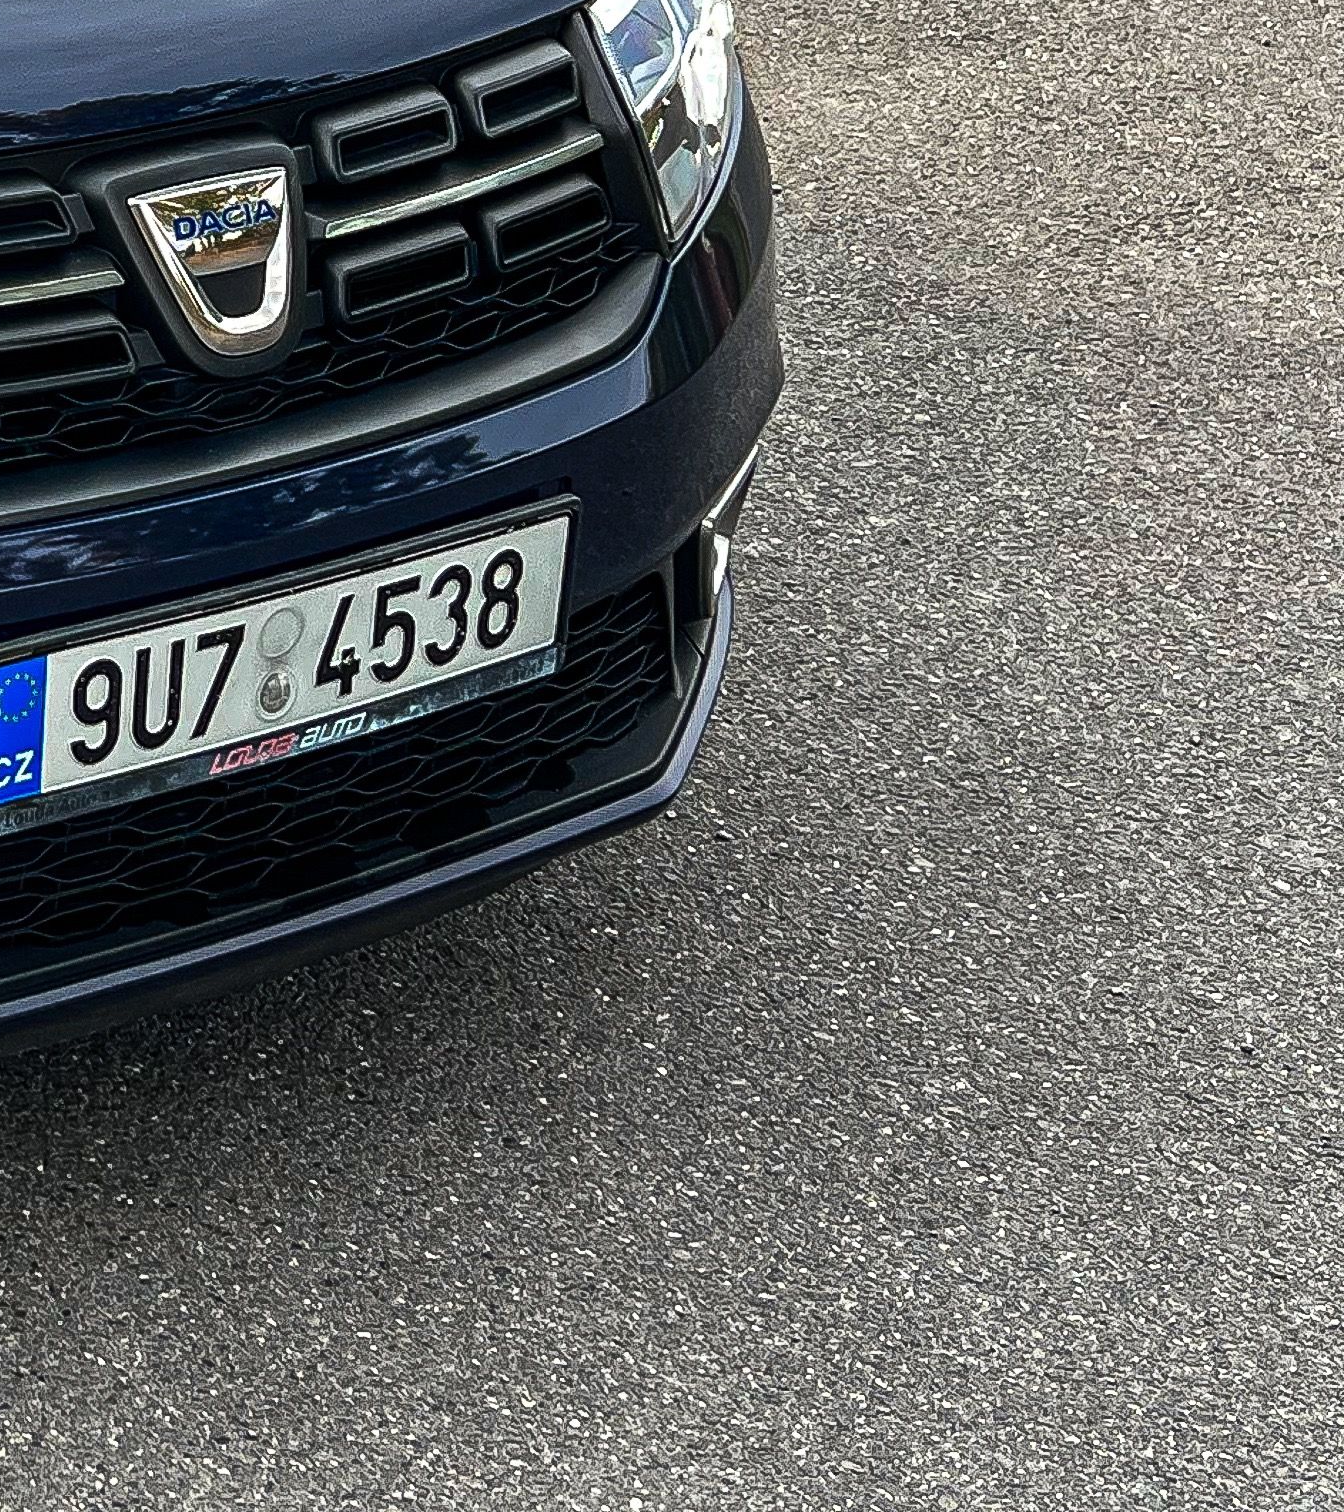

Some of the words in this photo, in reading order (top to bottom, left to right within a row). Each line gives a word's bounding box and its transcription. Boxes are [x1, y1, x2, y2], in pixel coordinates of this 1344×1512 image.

[172, 198, 278, 242] DACIA
[69, 626, 247, 766] 9U7
[314, 548, 525, 696] 4538
